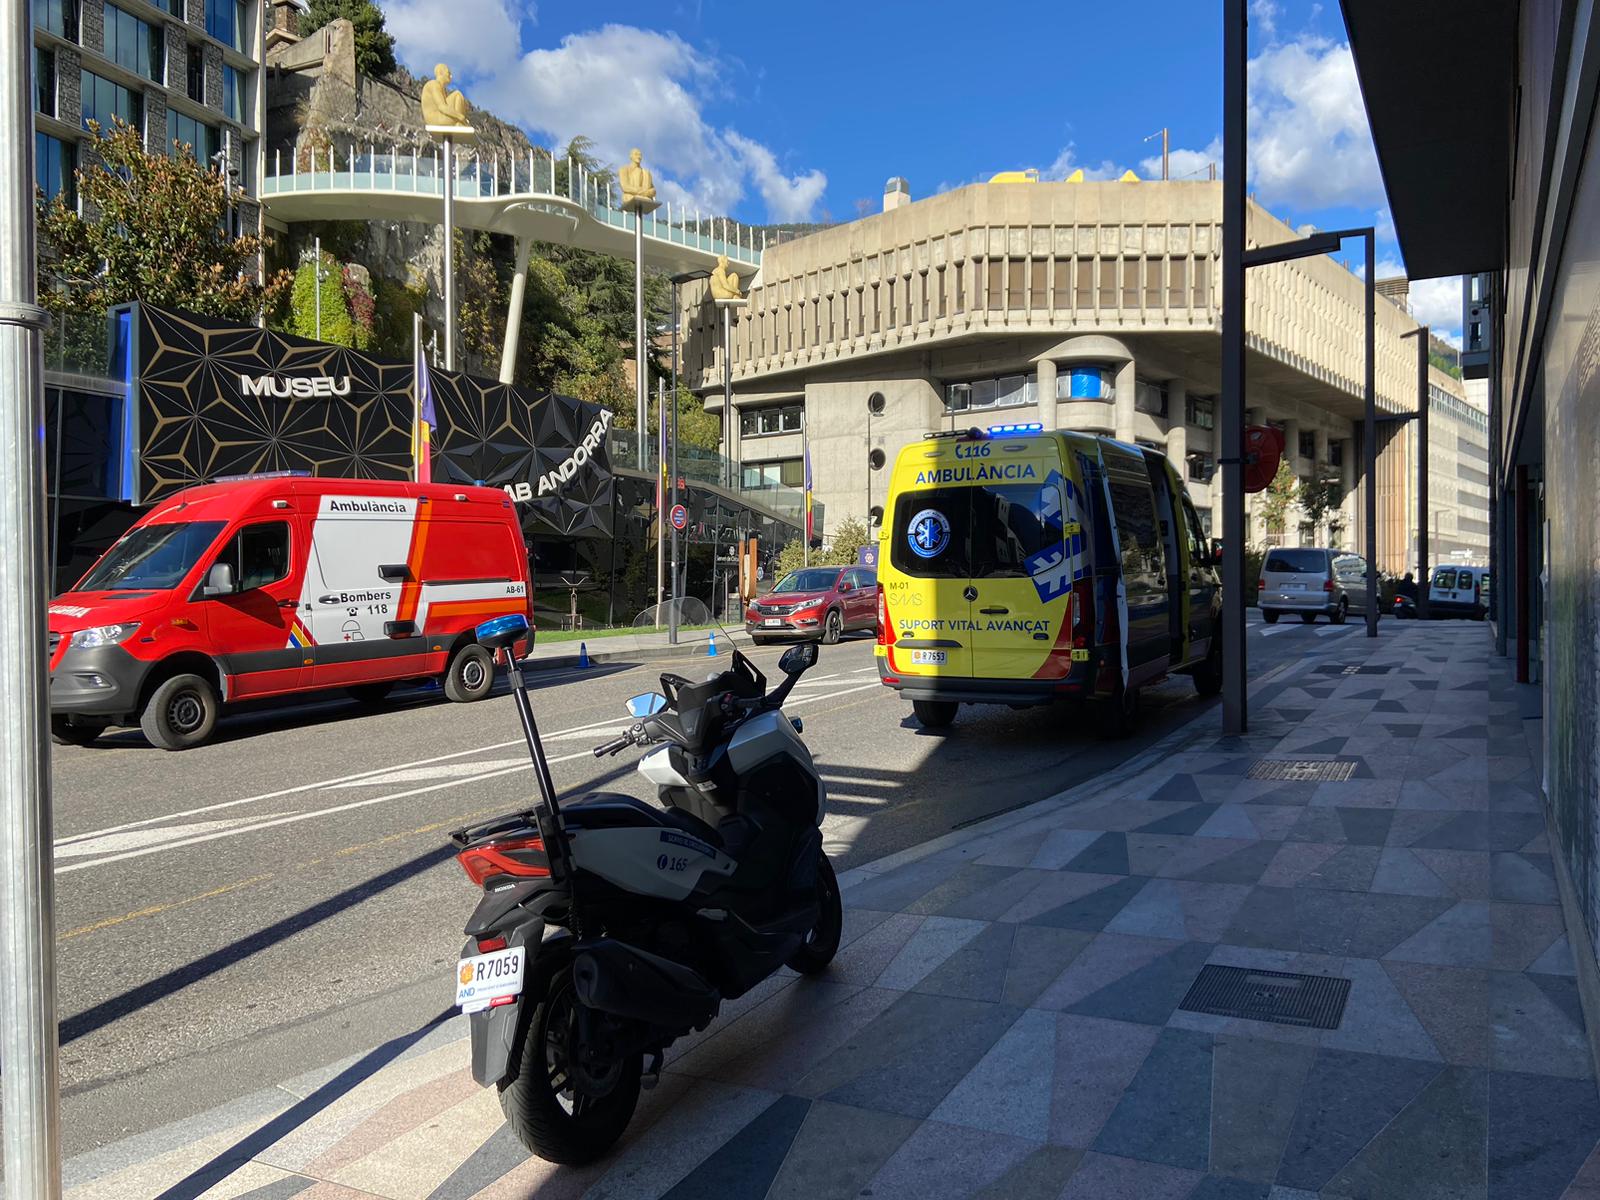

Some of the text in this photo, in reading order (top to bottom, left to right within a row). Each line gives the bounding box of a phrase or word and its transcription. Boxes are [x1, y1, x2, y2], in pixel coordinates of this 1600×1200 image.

[241, 375, 350, 397] MUSEU
[538, 409, 613, 496] ANDORRA
[964, 442, 991, 458] 116
[915, 463, 1036, 484] AMBULÀNCIA
[330, 500, 407, 512] Ambulància
[506, 585, 524, 594] AB-61
[889, 582, 909, 590] M-01
[340, 591, 391, 603] Bombers
[367, 604, 388, 615] 118
[899, 619, 1050, 634] SUPORT VITAL AVANÇAT
[669, 857, 688, 871] 165
[476, 955, 519, 981] R7059
[459, 987, 475, 998] AND
